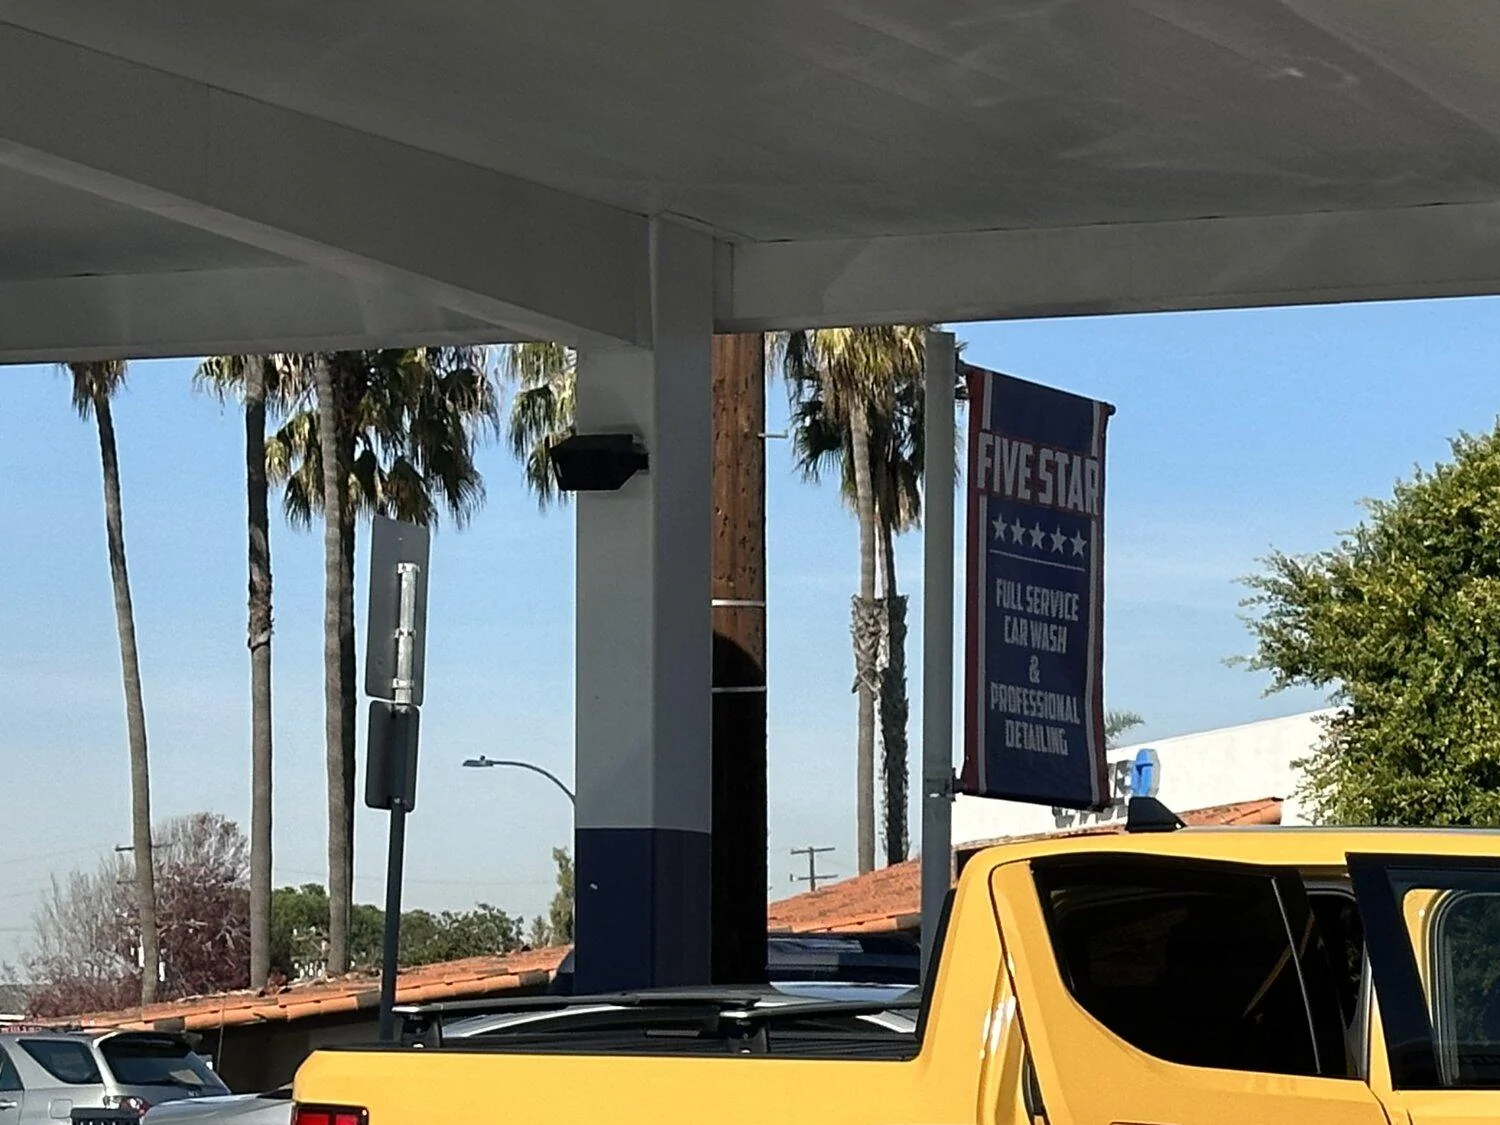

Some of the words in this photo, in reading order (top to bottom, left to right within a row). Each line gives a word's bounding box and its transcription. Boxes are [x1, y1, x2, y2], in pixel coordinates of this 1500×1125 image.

[977, 432, 1033, 500] FIVE
[1038, 448, 1099, 516] STAR
[996, 578, 1024, 611] FULL
[1025, 584, 1080, 622] SERVICE
[1004, 615, 1028, 647] CAR
[1029, 620, 1068, 654] WASH
[1029, 655, 1040, 684] &
[990, 681, 1081, 724] PROFESSIONAL
[1004, 719, 1069, 756] DETAILING
